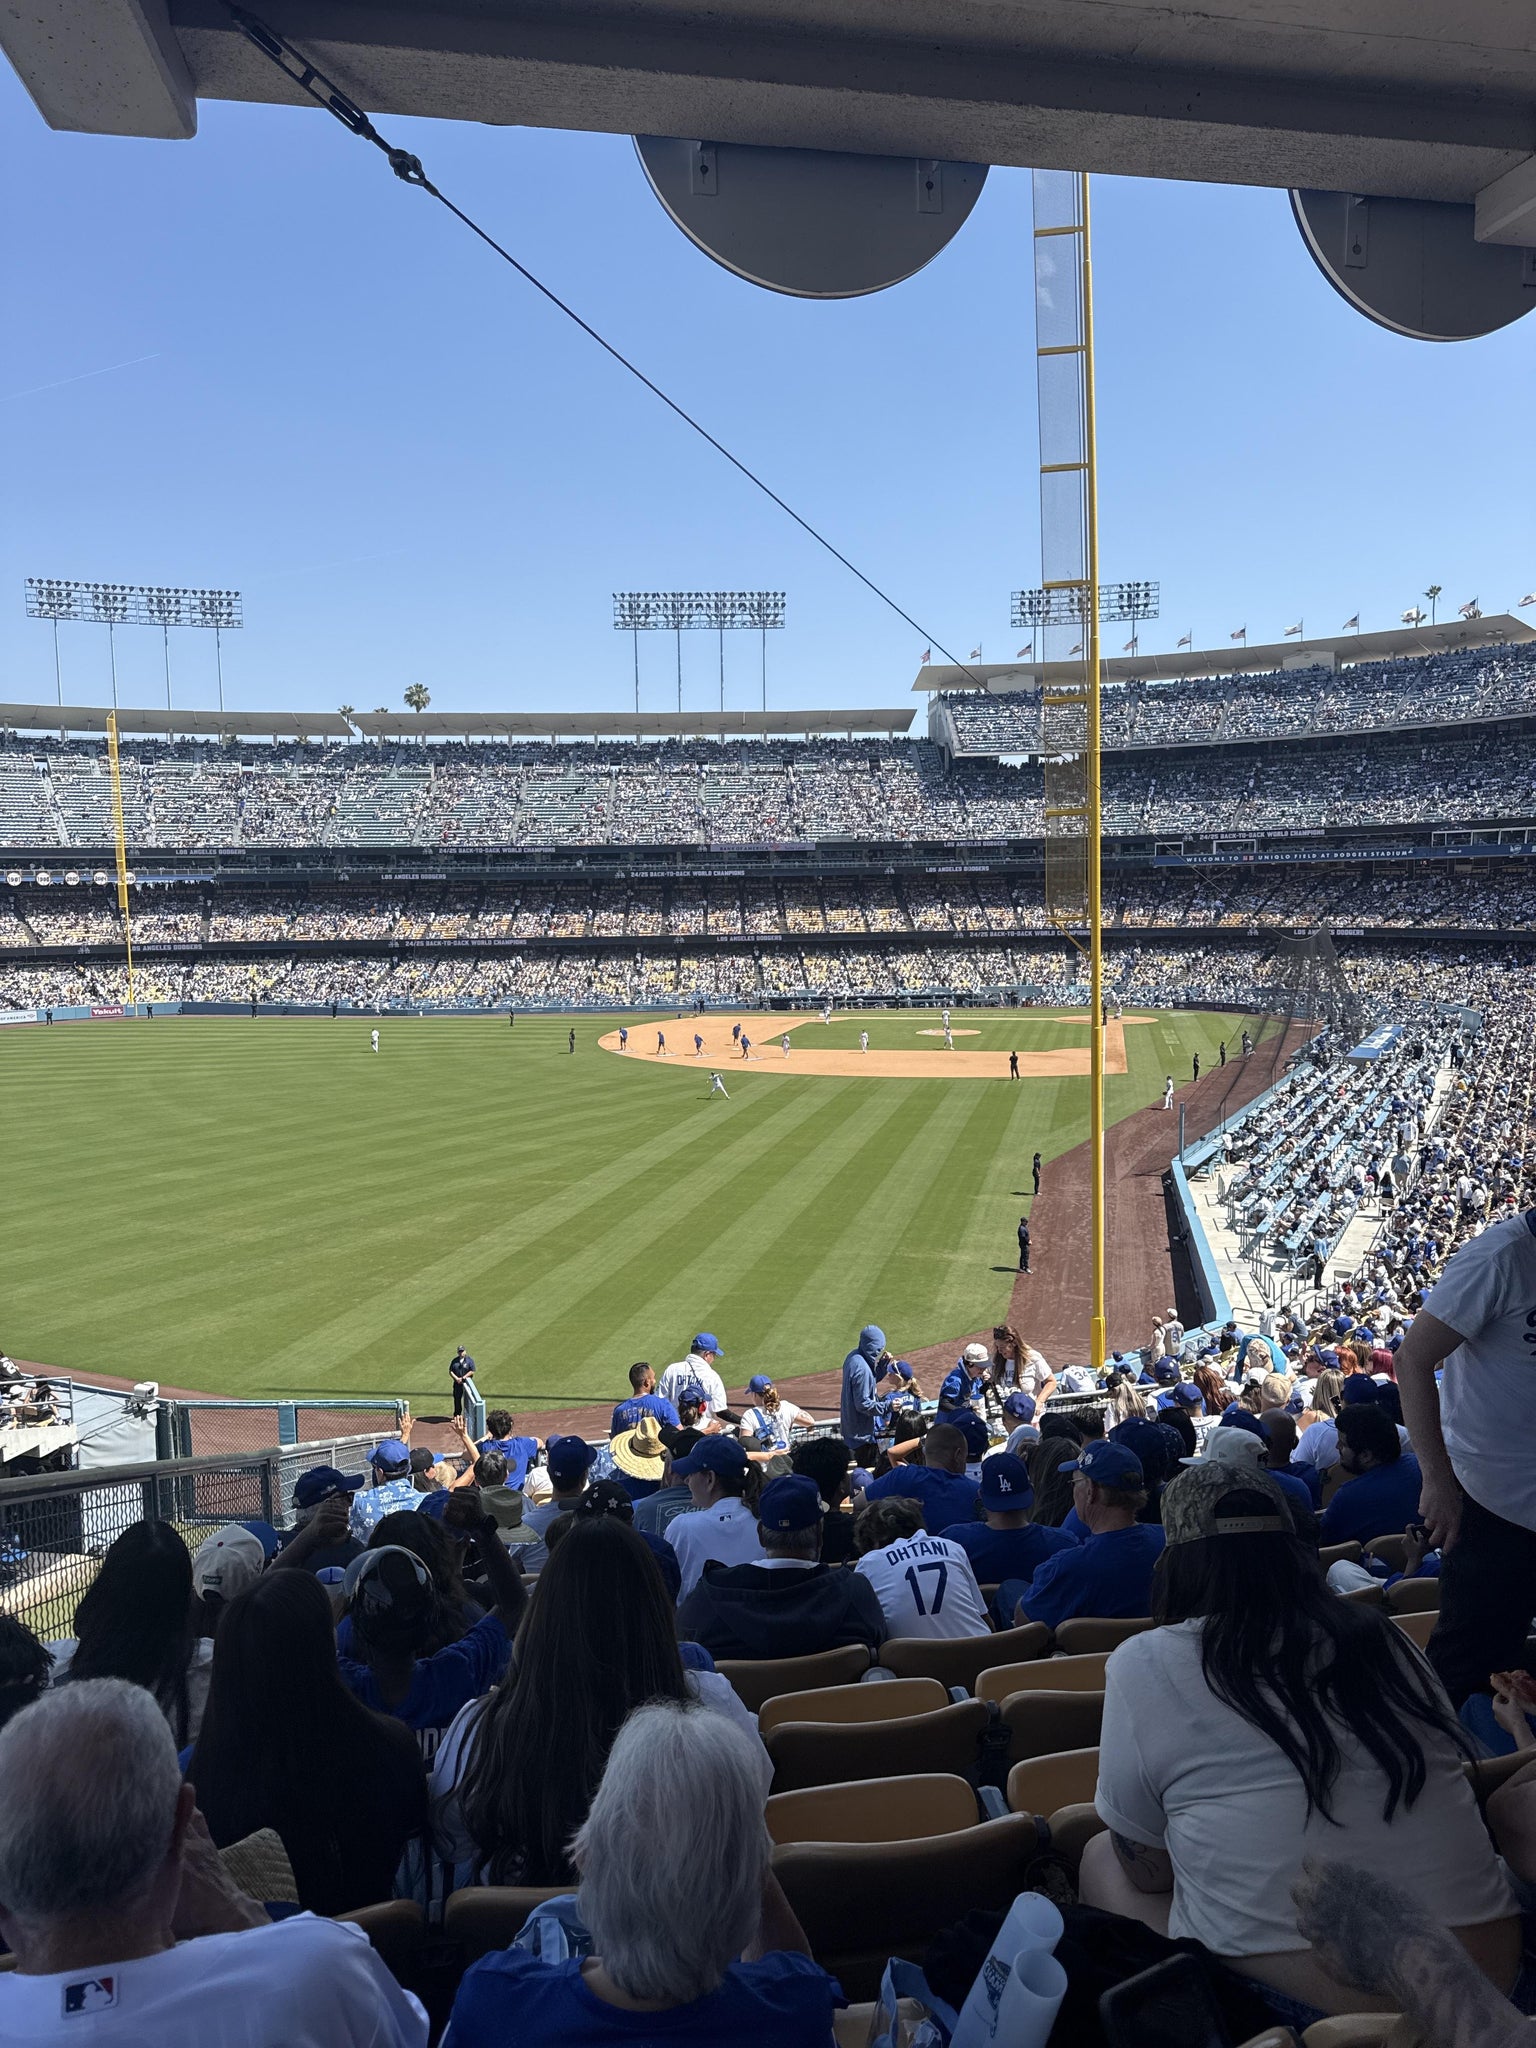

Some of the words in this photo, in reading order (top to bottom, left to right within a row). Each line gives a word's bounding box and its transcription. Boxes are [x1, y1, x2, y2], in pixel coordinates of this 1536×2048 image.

[1290, 829, 1325, 837] CHAMPIONS
[173, 943, 203, 951] DODGERS
[92, 1007, 123, 1015] Yakult
[998, 1474, 1013, 1492] LA
[886, 1541, 949, 1566] OHTANI
[904, 1561, 948, 1616] 17
